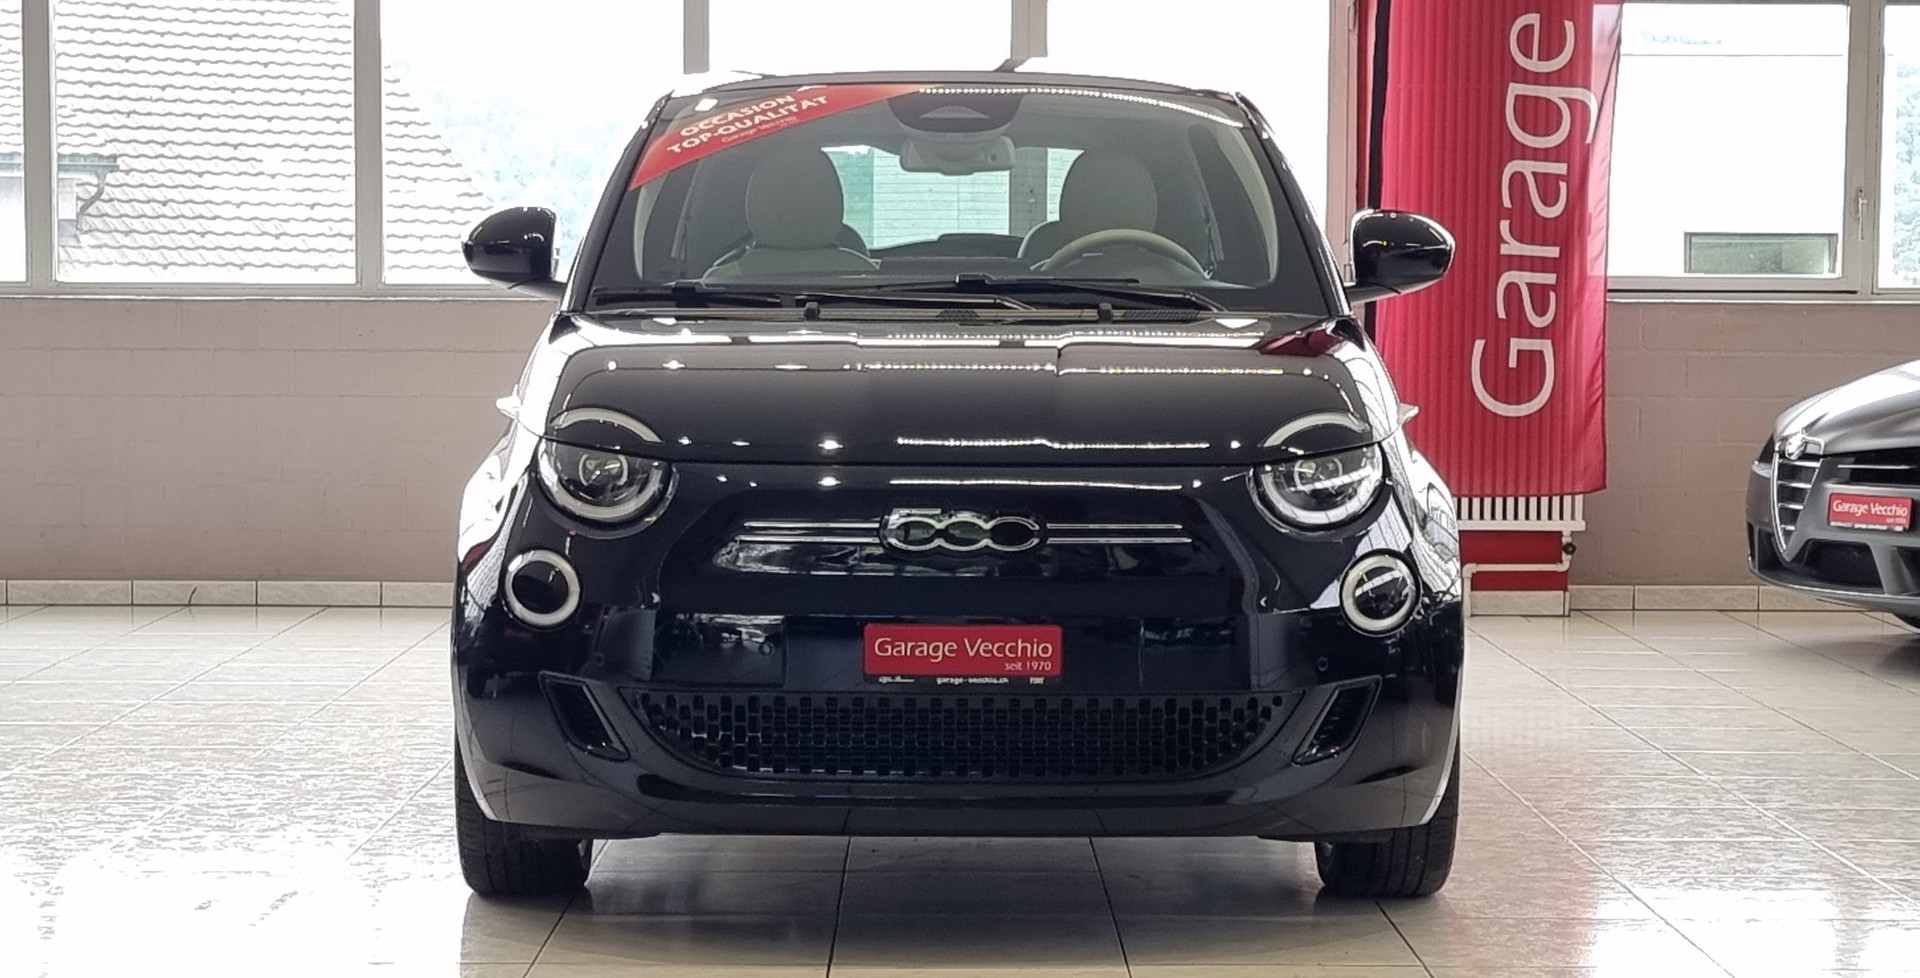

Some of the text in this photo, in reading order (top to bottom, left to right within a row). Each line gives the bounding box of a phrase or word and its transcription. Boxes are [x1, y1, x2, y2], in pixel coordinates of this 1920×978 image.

[680, 95, 796, 136] OCCASION
[1471, 13, 1599, 417] Garage
[1832, 500, 1908, 517] Garage Vecchio
[874, 637, 1053, 663] Garage Vecchio
[1004, 661, 1052, 671] seit 1970
